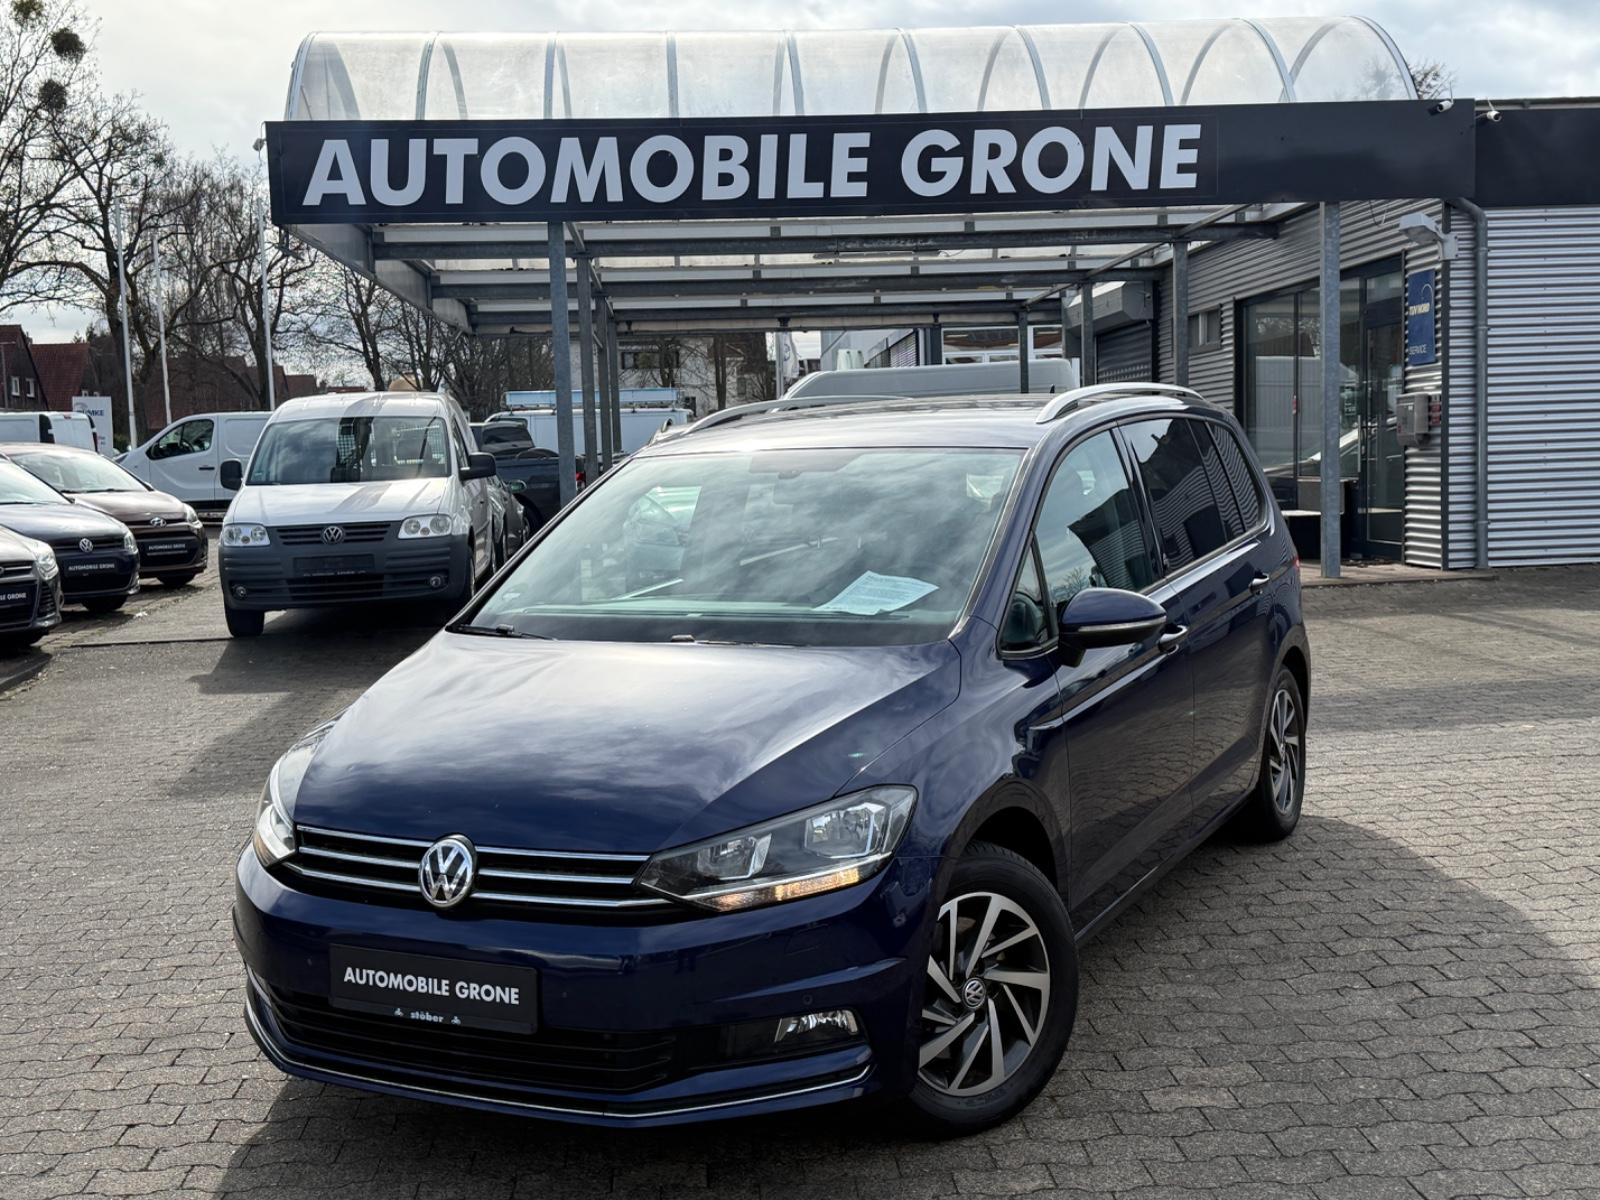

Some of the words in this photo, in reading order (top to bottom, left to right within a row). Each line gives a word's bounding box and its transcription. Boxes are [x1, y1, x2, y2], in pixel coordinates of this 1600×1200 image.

[302, 132, 871, 206] AUTOMOBILE
[901, 123, 1202, 197] GRONE
[1409, 344, 1428, 355] SERVICE
[68, 563, 98, 571] AUTOMOBILE
[343, 966, 450, 997] AUTOMOBILE
[455, 981, 520, 1005] GRONE
[410, 1010, 444, 1023] stöber
